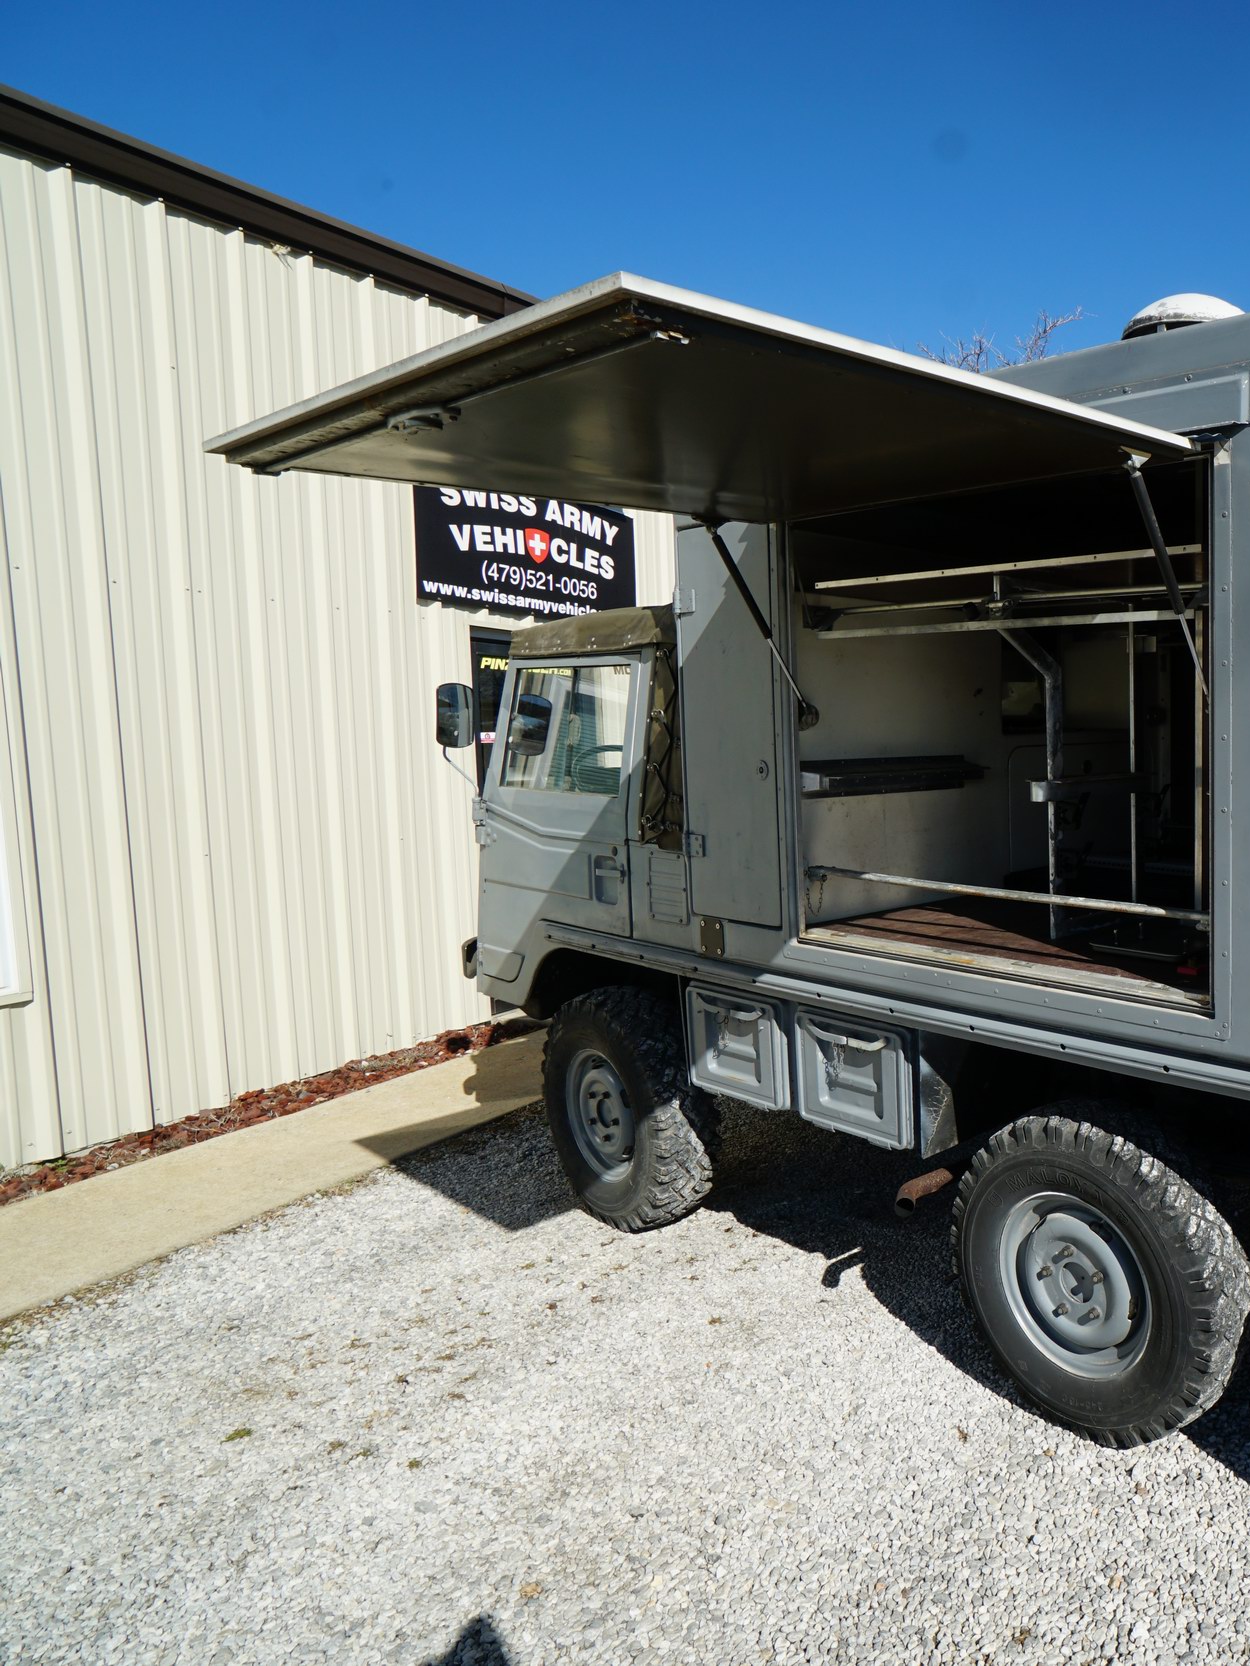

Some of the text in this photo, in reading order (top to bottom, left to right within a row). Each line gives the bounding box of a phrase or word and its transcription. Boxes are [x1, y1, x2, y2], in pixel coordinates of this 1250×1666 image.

[438, 487, 620, 547] SWISS ARMY
[422, 579, 602, 616] www.swissarmyvehicl
[481, 559, 598, 600] (479)521-0056
